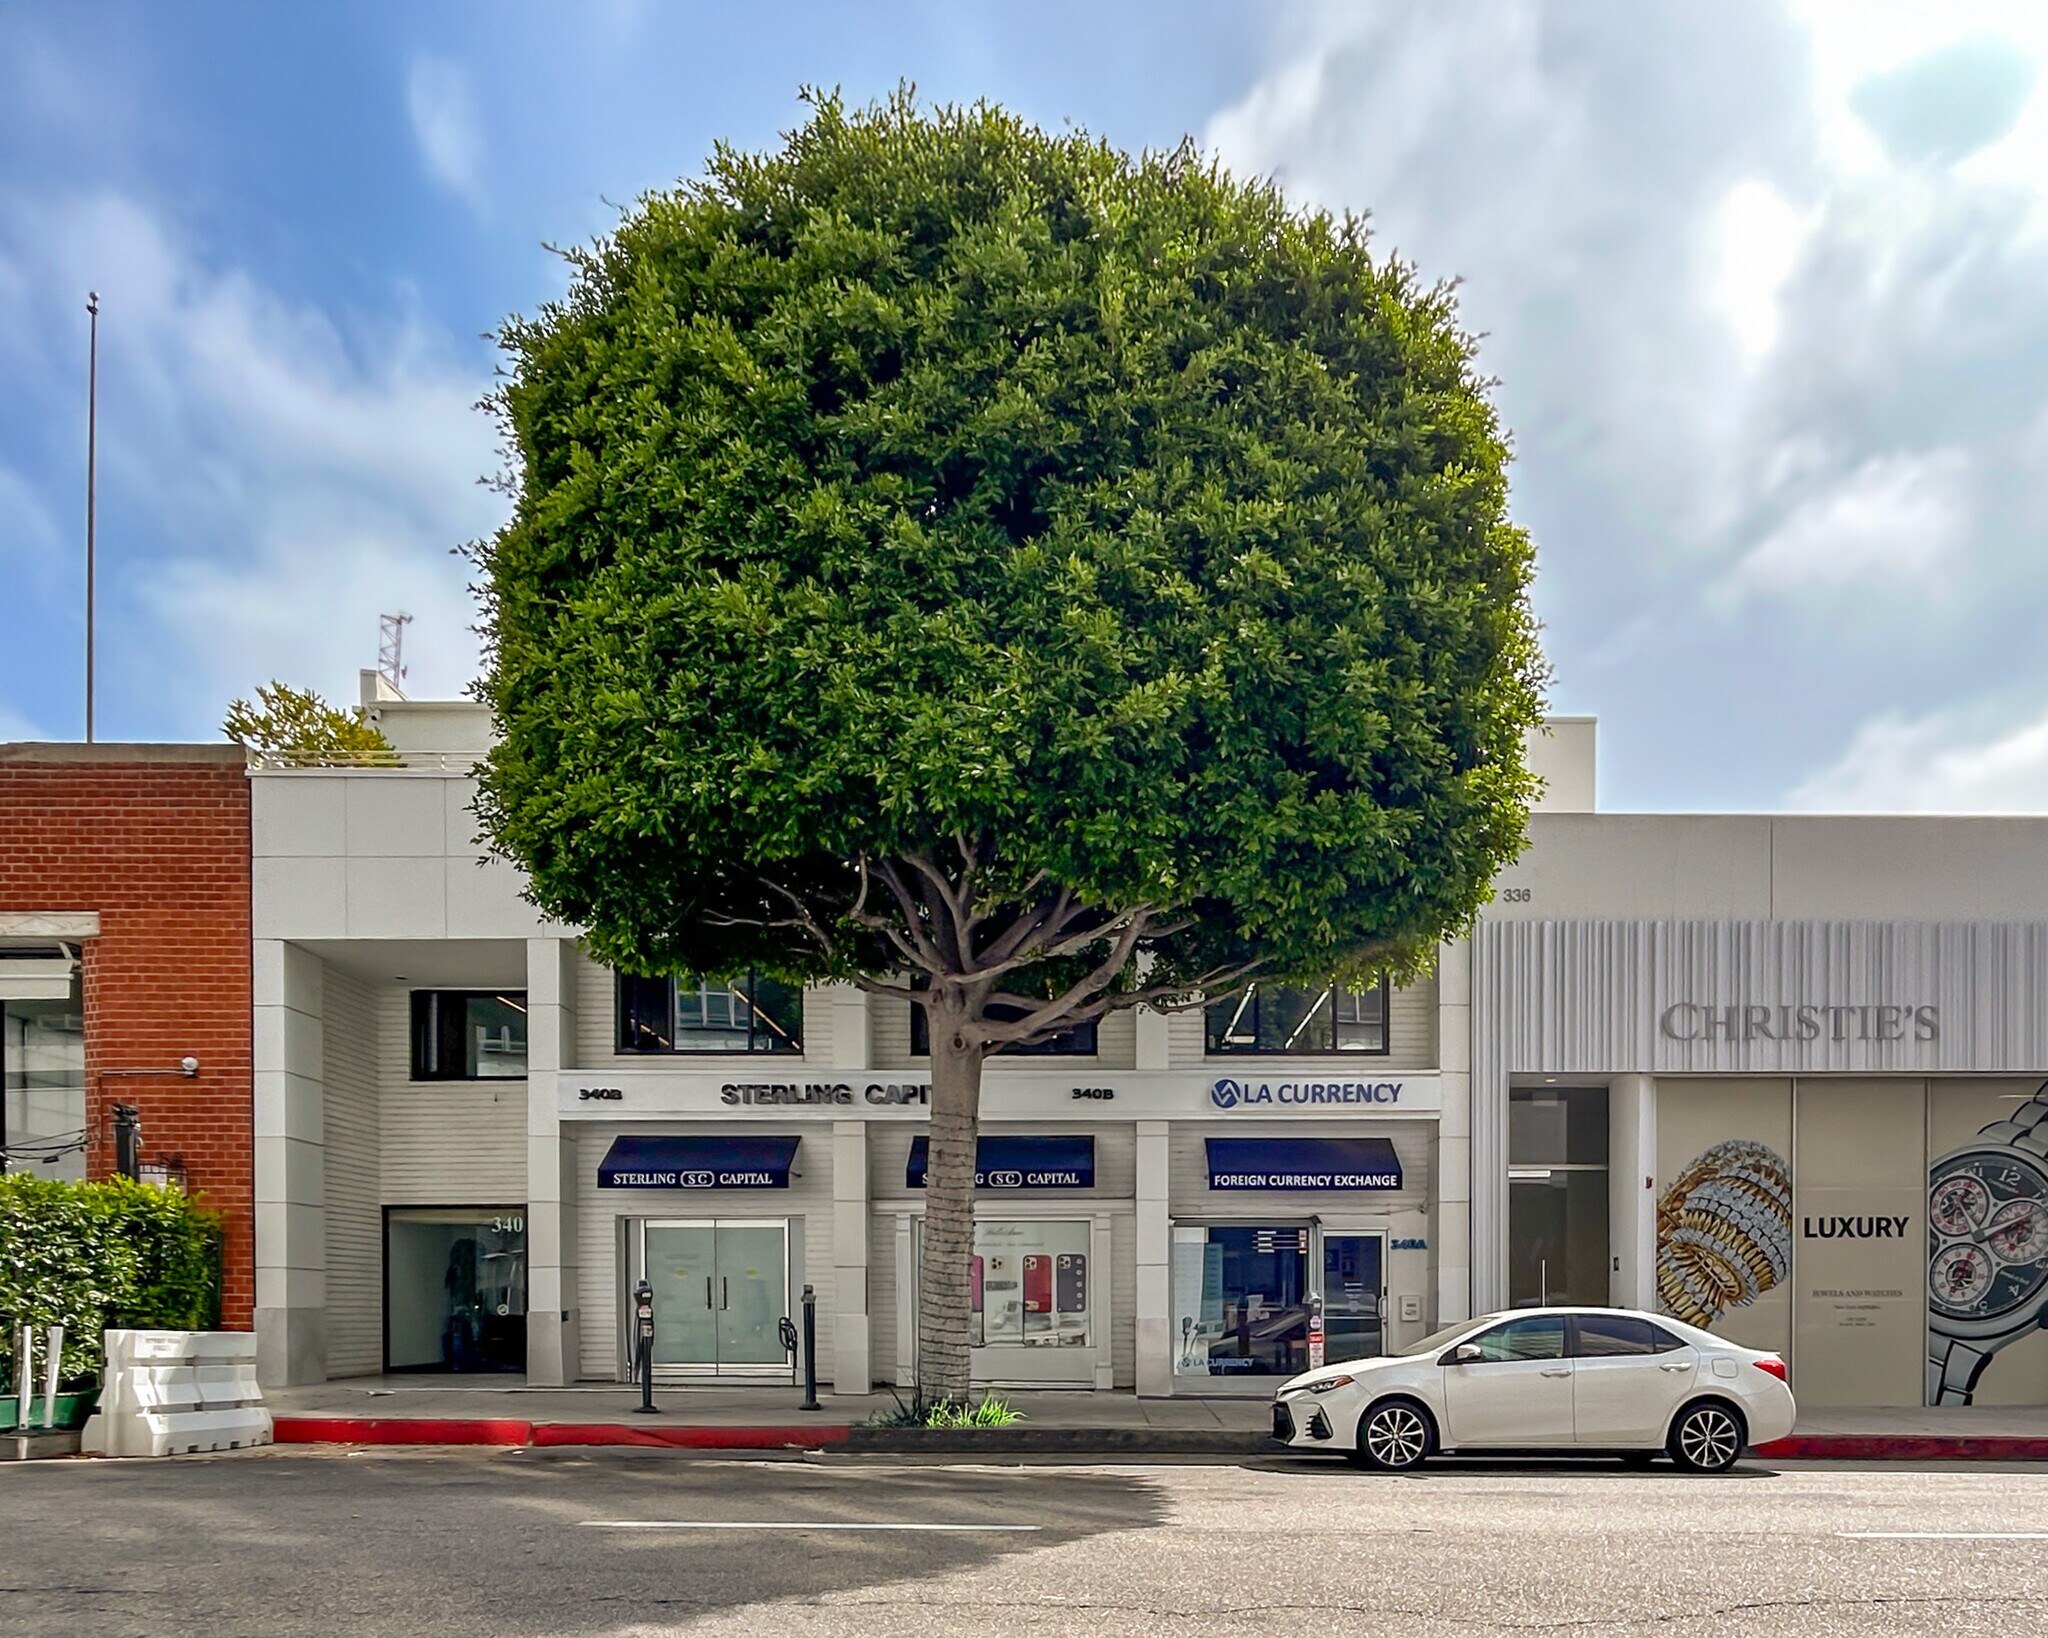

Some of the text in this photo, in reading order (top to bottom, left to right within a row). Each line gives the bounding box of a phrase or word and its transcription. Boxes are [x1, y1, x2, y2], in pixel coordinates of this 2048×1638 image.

[1503, 888, 1531, 903] 336
[578, 1088, 623, 1101] 340B
[721, 1084, 853, 1105] STERLING
[1071, 1087, 1114, 1100] 340B
[1244, 1083, 1402, 1104] LA CURRENCY
[613, 1173, 676, 1185] STERLING
[719, 1173, 773, 1185] CAPITAL
[1027, 1173, 1080, 1185] CAPITAL
[1214, 1174, 1398, 1187] FOREIGN CURRENCY EXCHANGE
[1998, 1169, 2022, 1186] 12
[491, 1216, 524, 1233] 340
[1803, 1216, 1910, 1238] LUXURY
